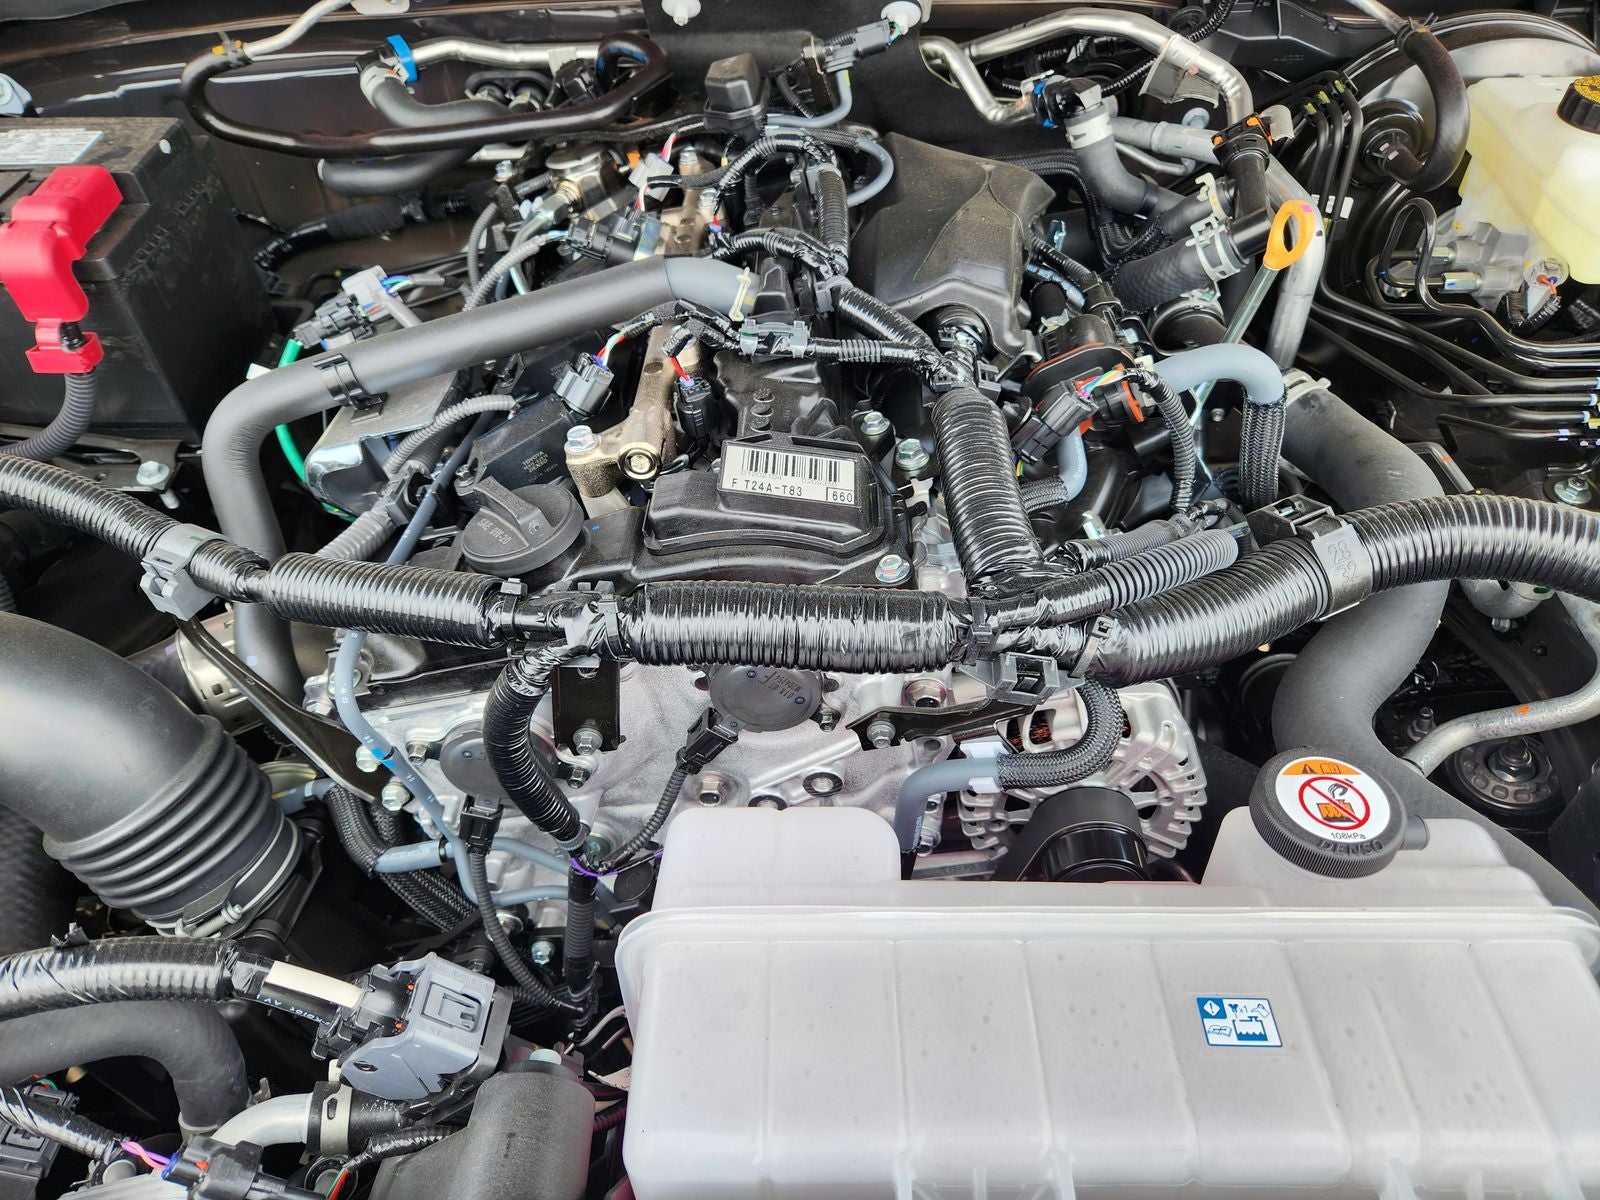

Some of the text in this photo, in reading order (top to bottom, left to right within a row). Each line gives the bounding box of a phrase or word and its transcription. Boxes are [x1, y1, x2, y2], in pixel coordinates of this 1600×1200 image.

[522, 451, 545, 466] TOYOTA
[731, 478, 853, 503] F T24A-T83 660
[1331, 832, 1366, 840] 108kPa
[1318, 839, 1385, 856] DENSO
